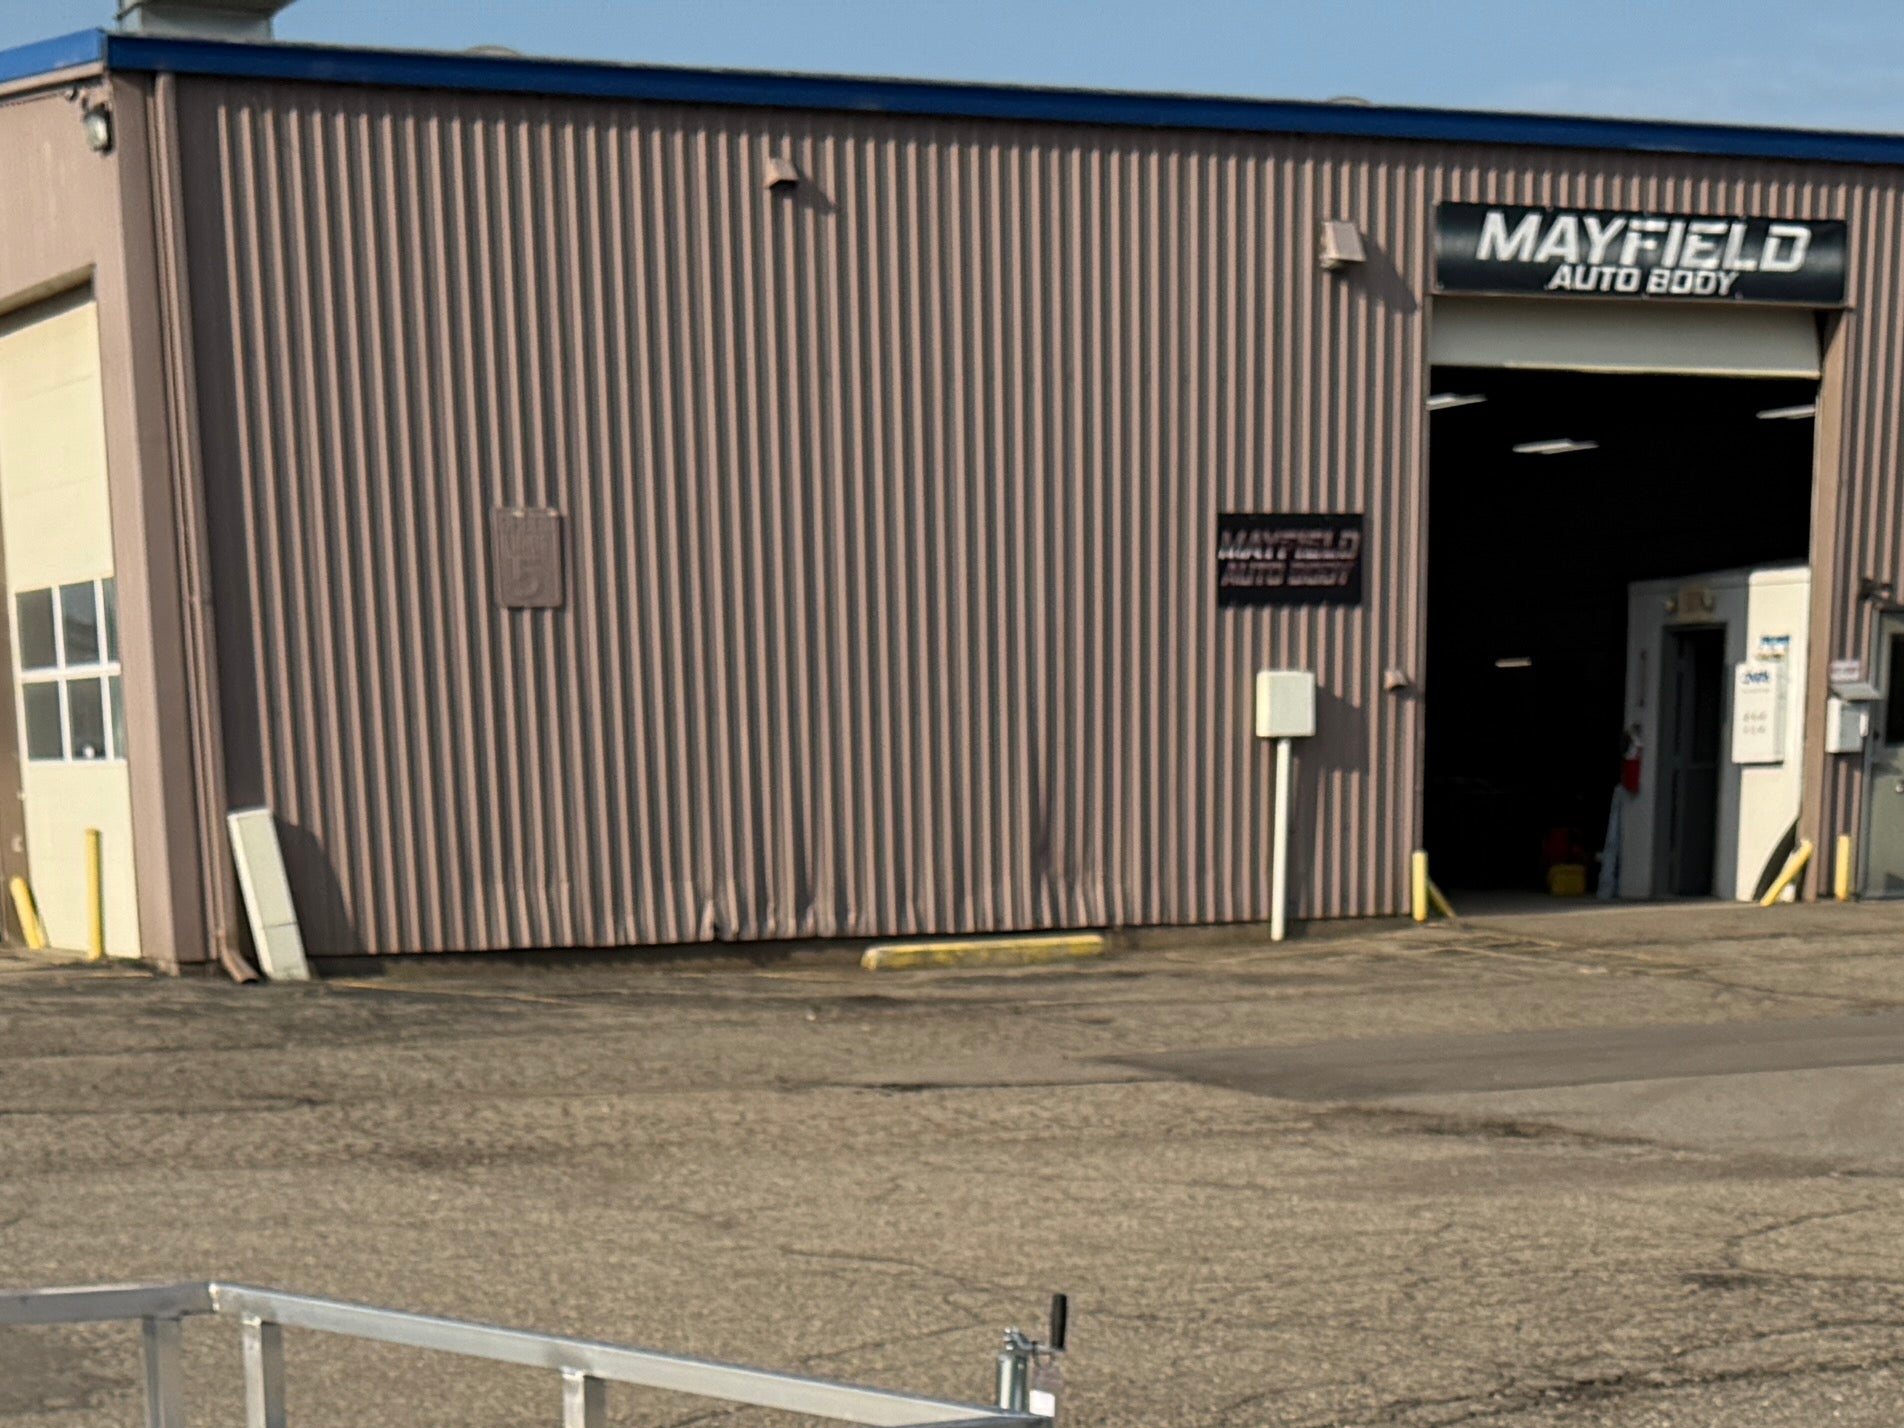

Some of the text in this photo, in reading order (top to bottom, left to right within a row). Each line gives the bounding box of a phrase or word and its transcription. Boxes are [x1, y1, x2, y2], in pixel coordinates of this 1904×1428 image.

[1476, 211, 1812, 273] MAYFIELD
[1547, 264, 1740, 297] AUTO BODY
[1218, 528, 1361, 560] MAYFIELD
[1220, 561, 1286, 587] AUTO
